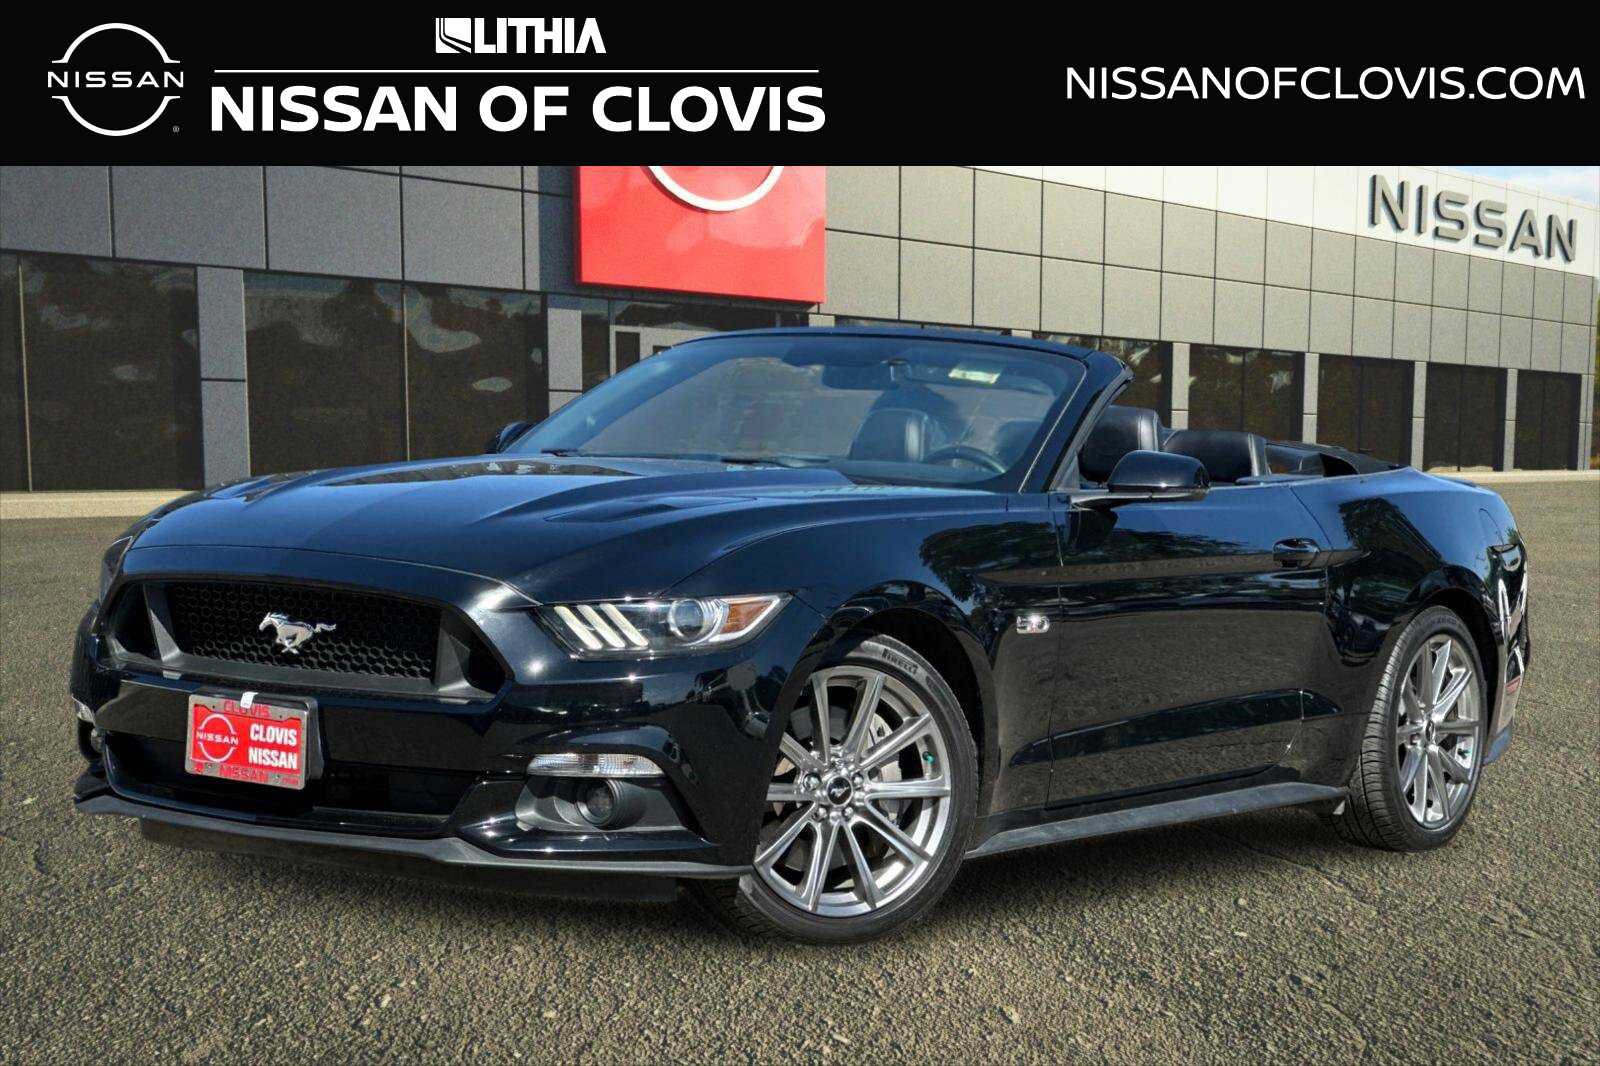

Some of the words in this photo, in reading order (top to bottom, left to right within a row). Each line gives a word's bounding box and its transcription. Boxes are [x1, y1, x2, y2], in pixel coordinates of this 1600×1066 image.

[1371, 174, 1577, 262] NISSAN
[196, 730, 239, 746] NISSAN
[249, 723, 298, 747] CLOVIS
[248, 746, 298, 770] NISSAN
